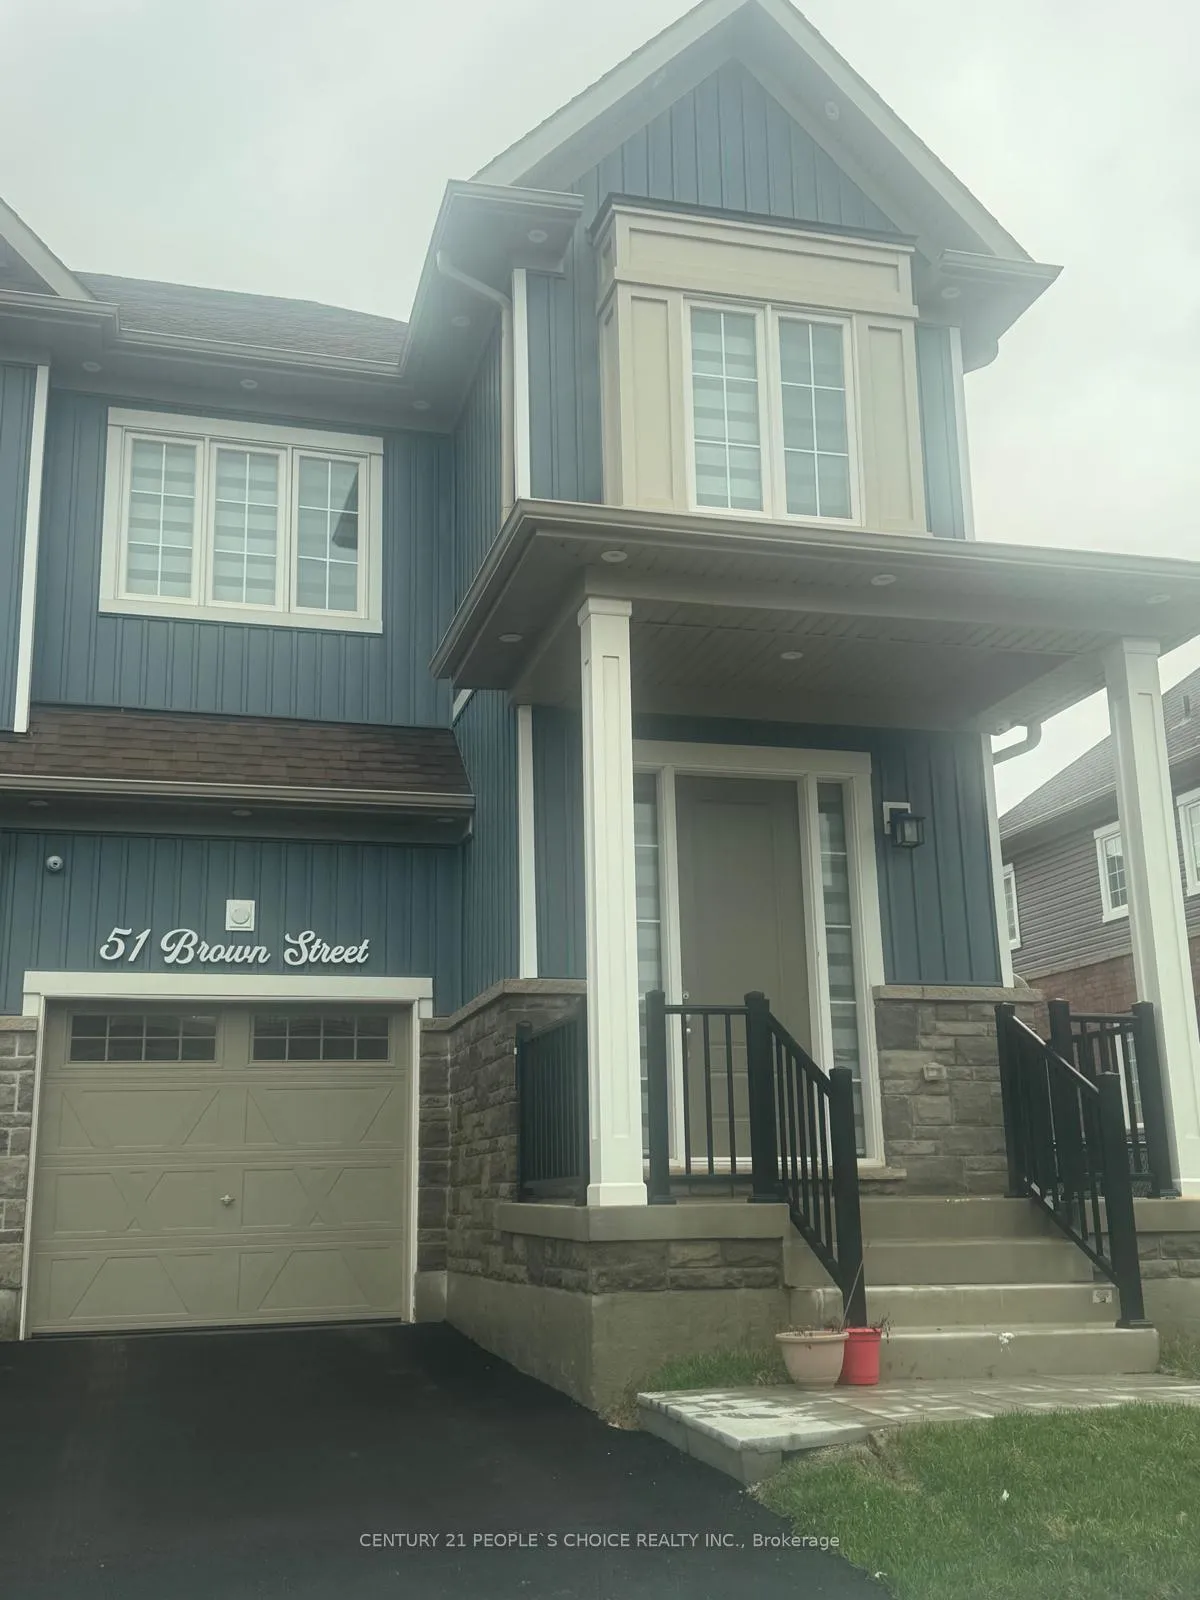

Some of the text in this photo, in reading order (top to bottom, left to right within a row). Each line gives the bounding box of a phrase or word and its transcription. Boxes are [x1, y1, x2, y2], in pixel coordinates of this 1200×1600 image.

[99, 927, 370, 966] 51 Brown Street
